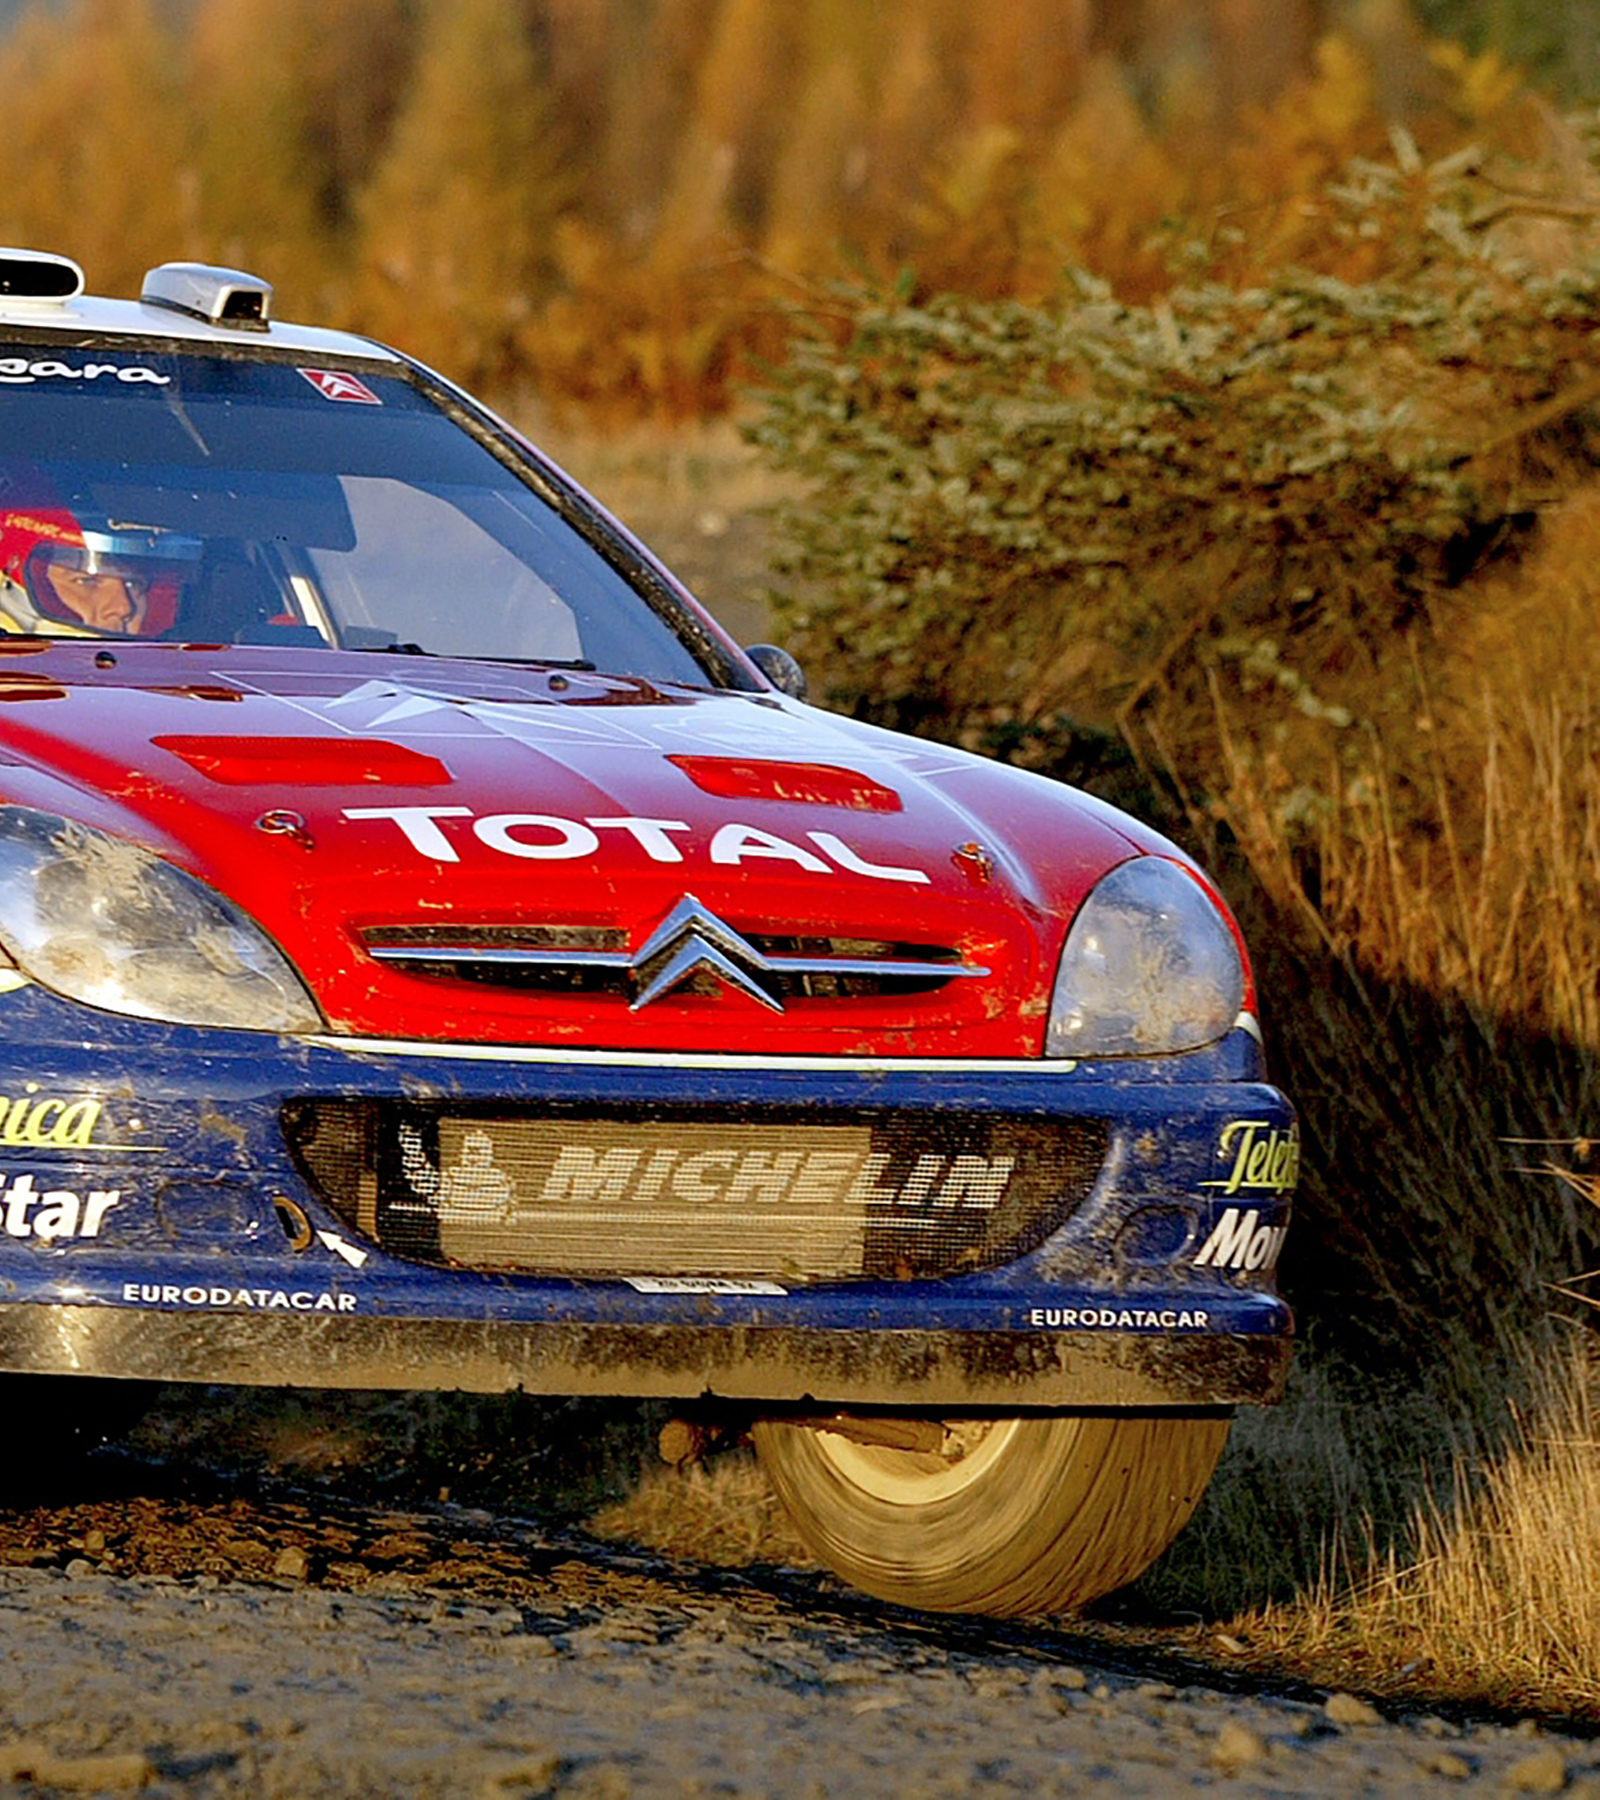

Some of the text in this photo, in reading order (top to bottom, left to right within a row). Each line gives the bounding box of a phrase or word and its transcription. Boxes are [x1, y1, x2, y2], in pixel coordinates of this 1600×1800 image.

[341, 806, 933, 885] TOTAL
[540, 1145, 1017, 1210] MICHELIN
[122, 1283, 357, 1312] EURODATACAR
[1030, 1308, 1209, 1328] EURODATACAR
